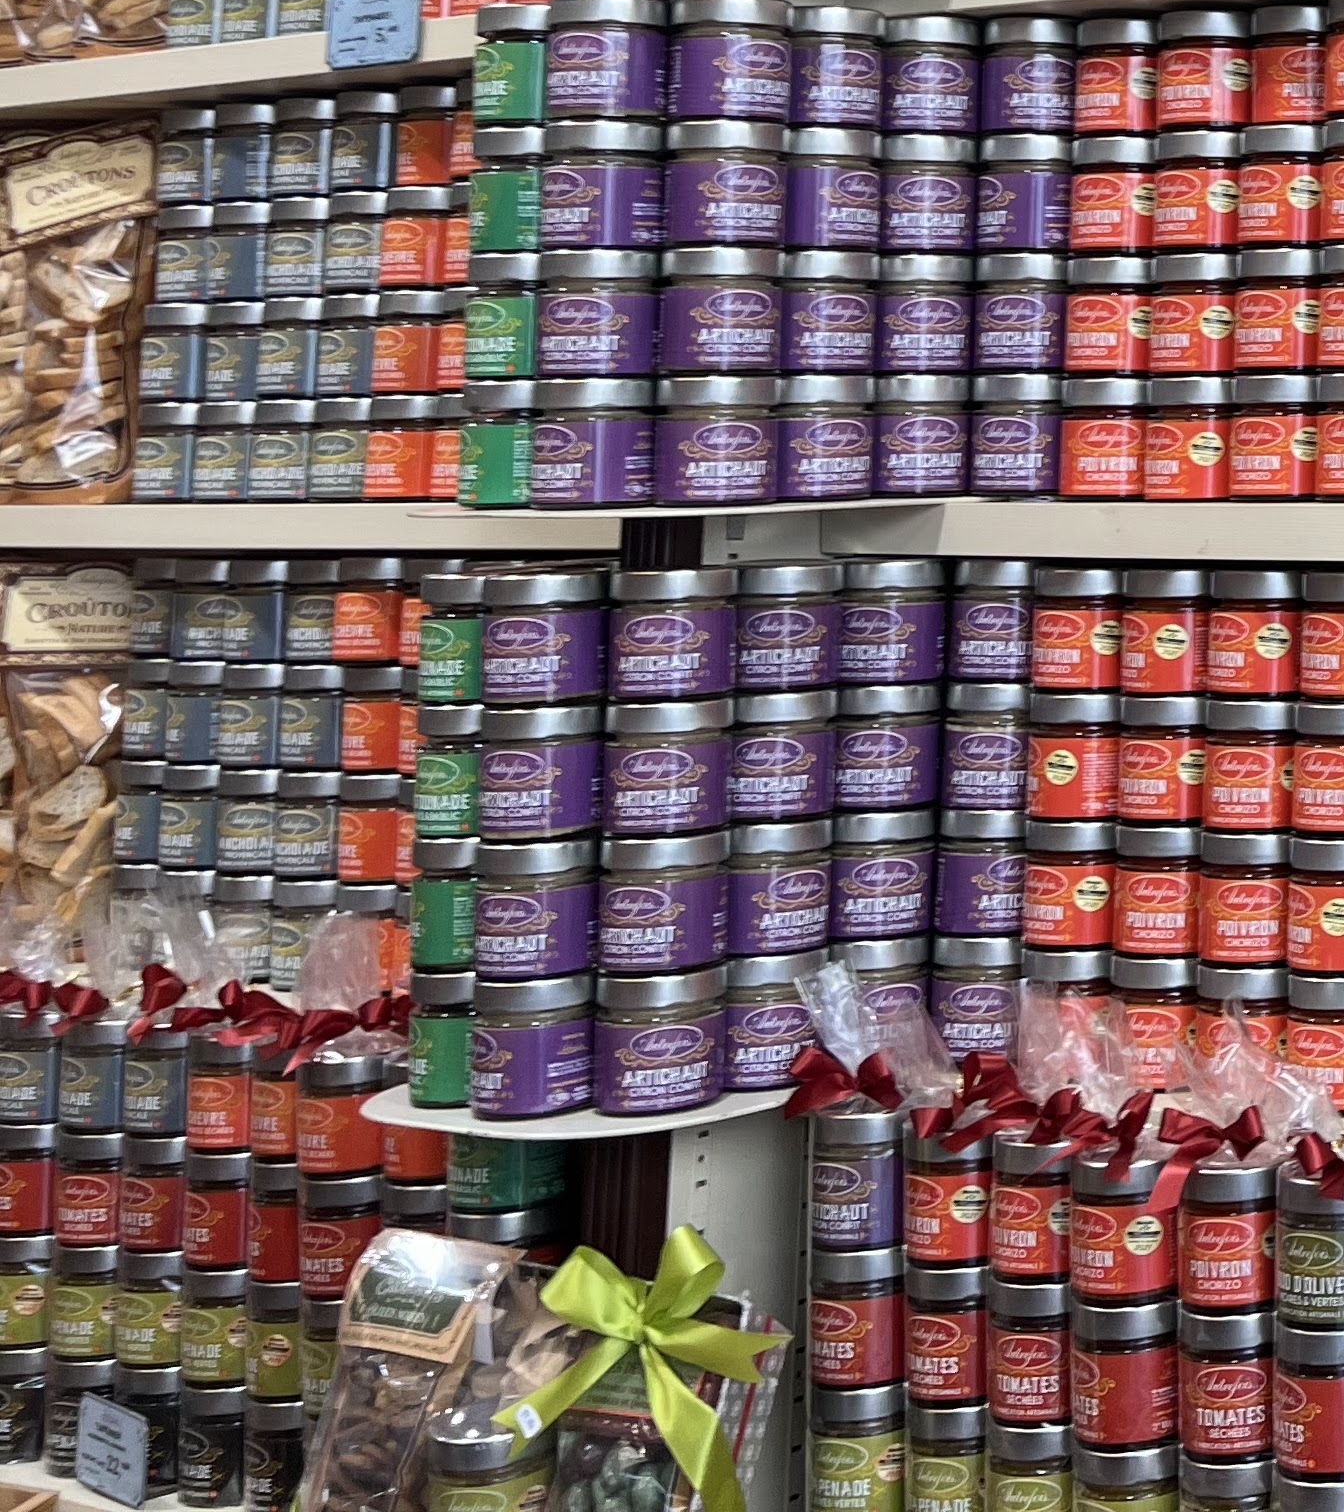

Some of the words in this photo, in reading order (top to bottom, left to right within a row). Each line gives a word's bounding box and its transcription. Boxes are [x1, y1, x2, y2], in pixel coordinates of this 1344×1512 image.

[1190, 1260, 1251, 1279] POIVRON
[1199, 1276, 1243, 1290] CHORIZO
[1197, 1407, 1266, 1428] TOMATES
